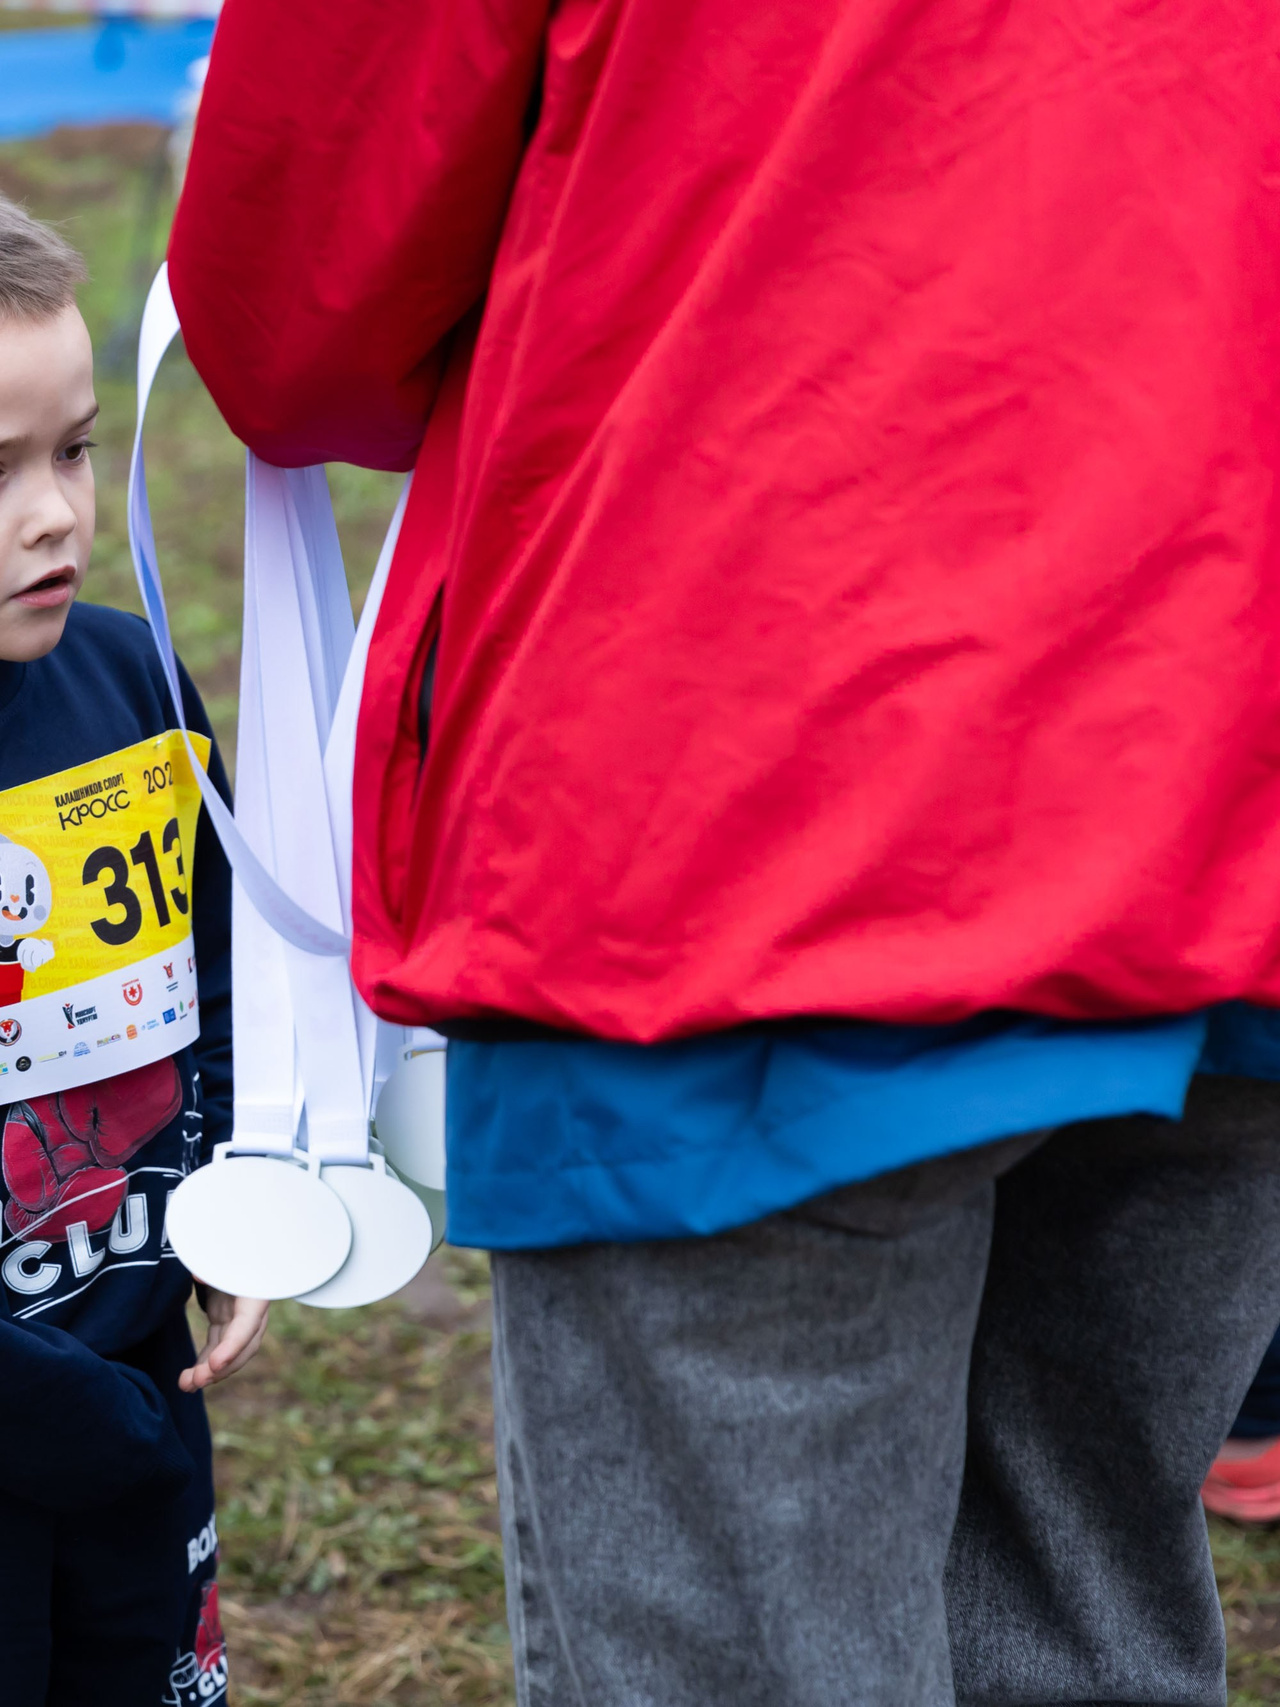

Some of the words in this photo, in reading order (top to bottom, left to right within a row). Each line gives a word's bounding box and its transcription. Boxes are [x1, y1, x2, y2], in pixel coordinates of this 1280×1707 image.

[54, 781, 103, 808] КАЛАШНИКОВ
[103, 772, 125, 790] СПОРТ
[143, 761, 174, 795] 202
[58, 789, 131, 831] КРОСС
[82, 817, 189, 946] 313
[1, 1189, 176, 1295] CLU
